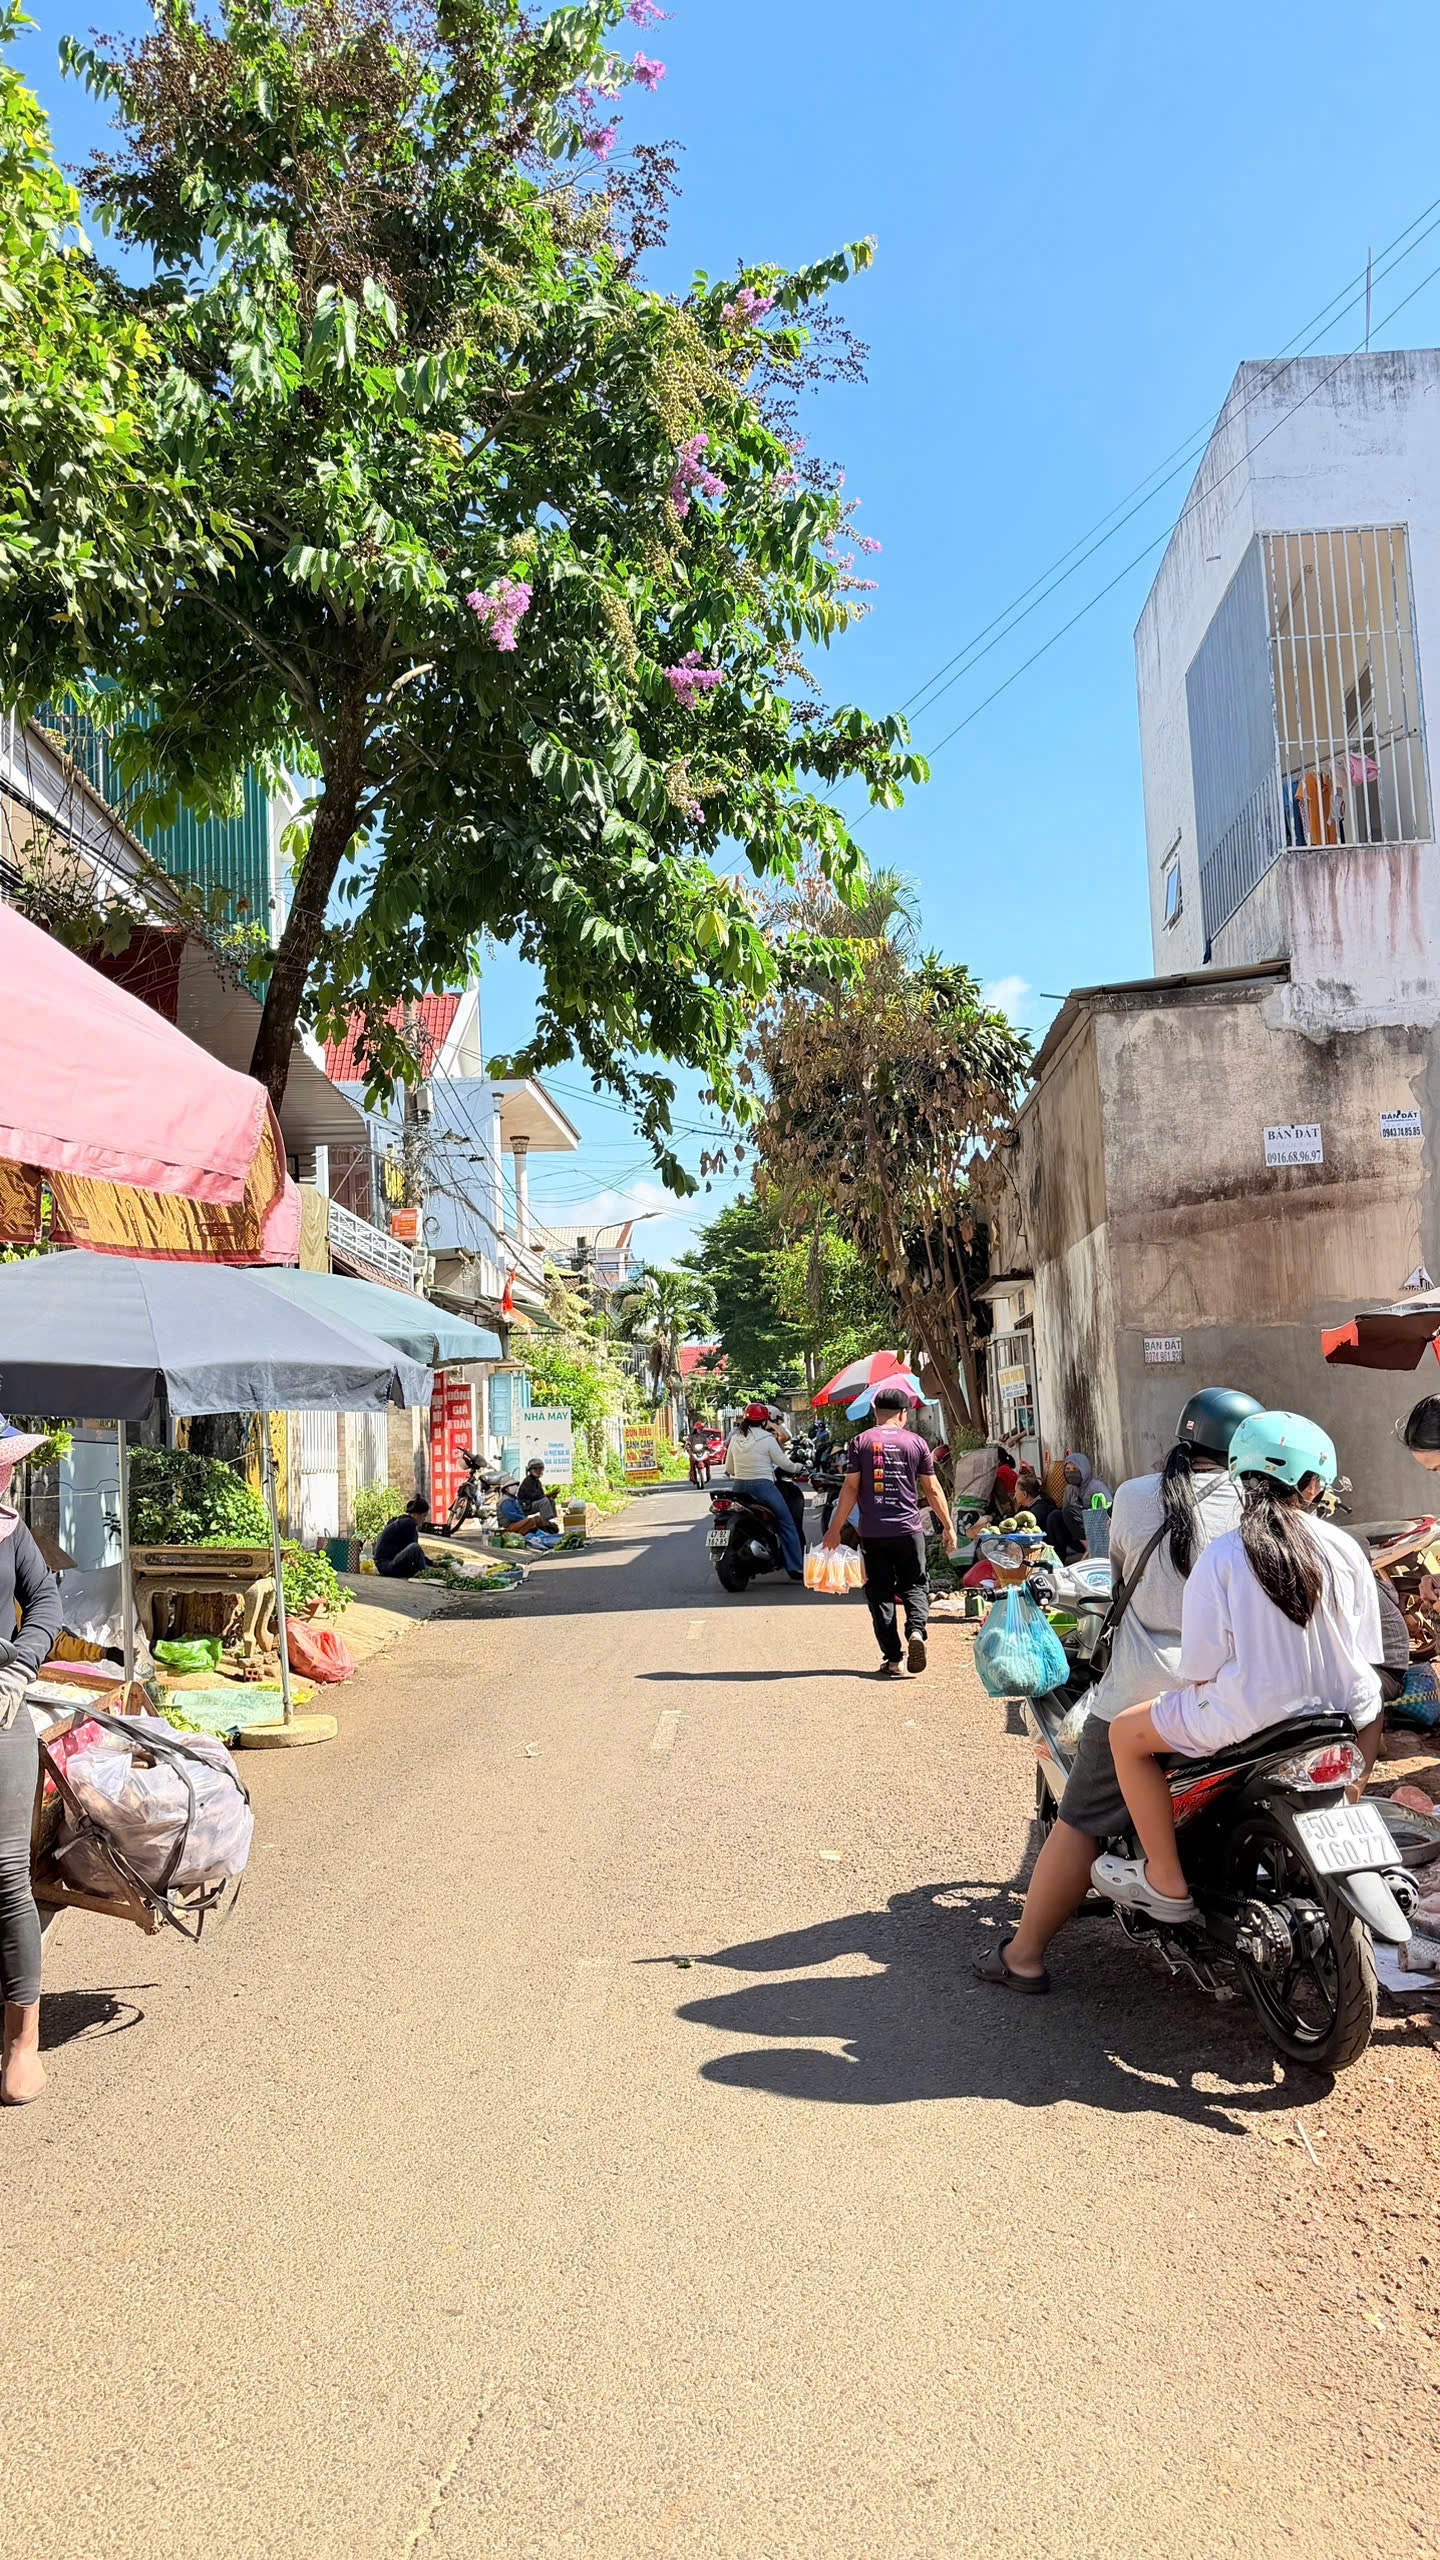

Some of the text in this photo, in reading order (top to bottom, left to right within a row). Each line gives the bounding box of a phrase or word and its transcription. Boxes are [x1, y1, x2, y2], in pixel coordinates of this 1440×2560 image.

[1267, 1126, 1320, 1140] BÁN ĐẤT
[1267, 1150, 1321, 1164] 0916.68.96.97
[452, 1402, 469, 1415] GIÁ
[524, 1410, 569, 1421] NHÀ MAY
[1316, 1834, 1389, 1869] 160.77
